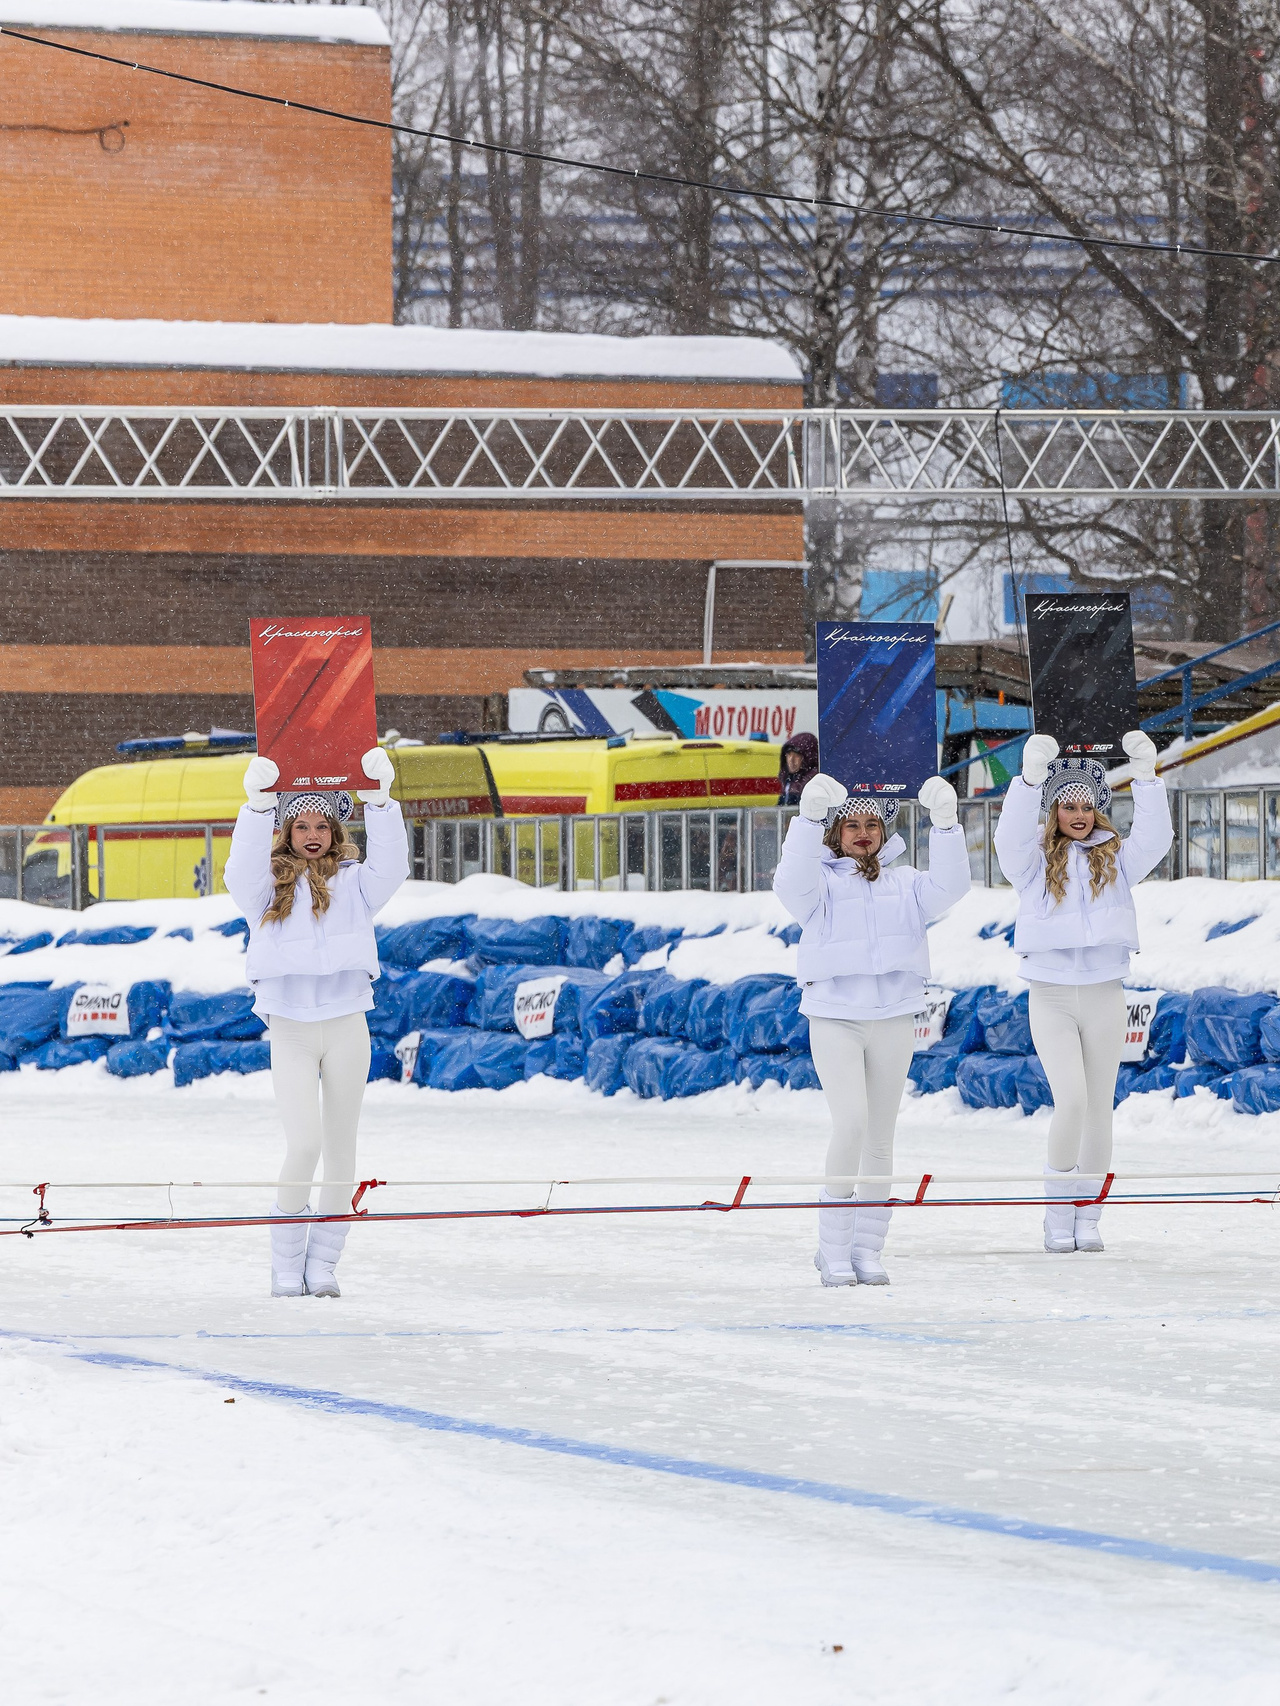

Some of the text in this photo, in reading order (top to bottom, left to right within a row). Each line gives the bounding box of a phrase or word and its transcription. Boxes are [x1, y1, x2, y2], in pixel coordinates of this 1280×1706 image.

[1033, 599, 1125, 620] Красногорск
[258, 624, 363, 646] Красногорск
[824, 627, 928, 651] Красногорск
[695, 705, 796, 739] МОТОШОУ
